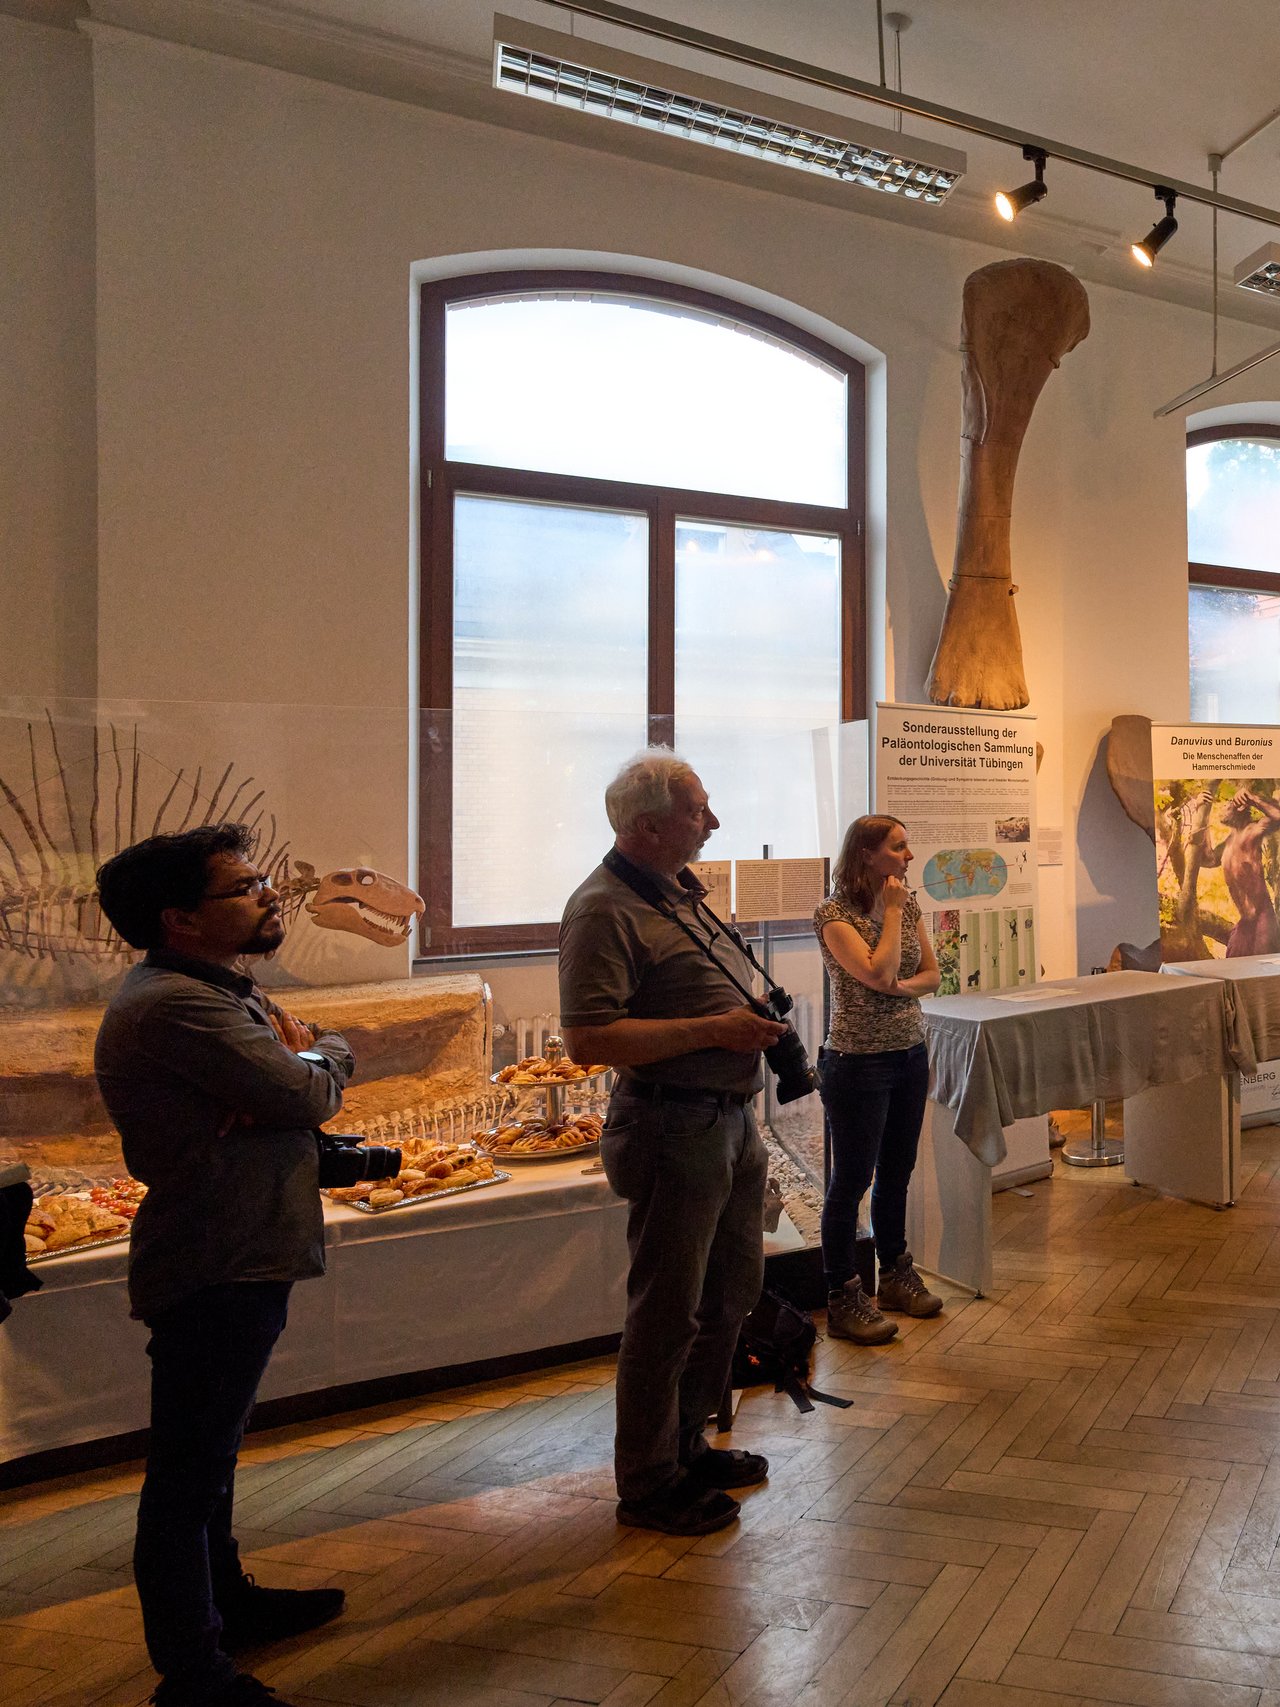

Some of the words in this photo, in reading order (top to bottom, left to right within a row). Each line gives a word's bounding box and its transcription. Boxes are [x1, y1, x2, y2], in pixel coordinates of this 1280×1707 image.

[902, 721, 1000, 739] Sonderausstellung
[1002, 728, 1018, 738] der
[881, 737, 981, 753] Paläontologischen
[984, 742, 1034, 757] Sammlung
[1170, 736, 1213, 746] Danuvius
[1215, 737, 1232, 746] und
[1234, 737, 1273, 747] Buronius
[899, 754, 918, 766] der
[920, 755, 977, 768] Universität
[979, 757, 1024, 771] Tübingen
[1182, 752, 1195, 760] Die
[1196, 752, 1251, 760] Menschenaffen
[1252, 752, 1264, 760] der
[1191, 763, 1256, 771] Hammerschmiede
